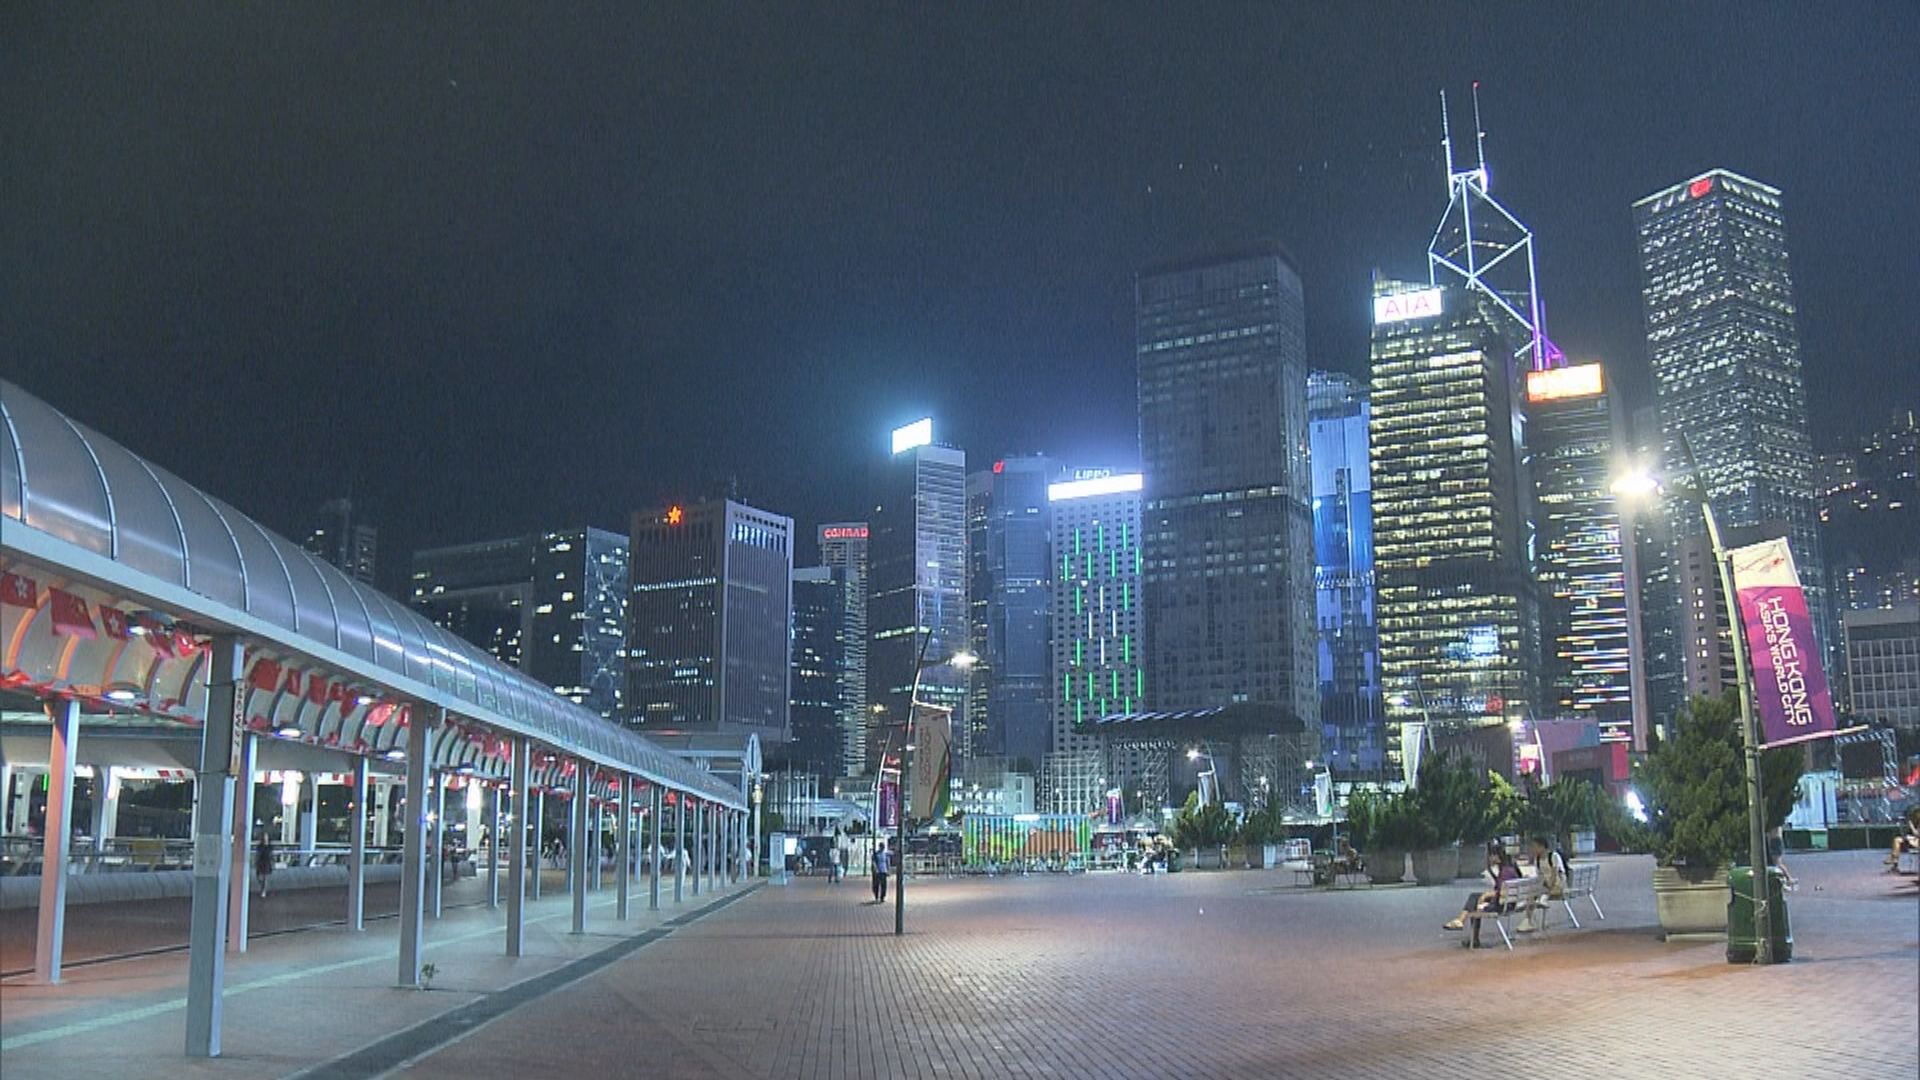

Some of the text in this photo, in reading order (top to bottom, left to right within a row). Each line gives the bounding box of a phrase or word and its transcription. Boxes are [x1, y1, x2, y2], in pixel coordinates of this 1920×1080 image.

[1384, 295, 1431, 317] AIA
[824, 527, 868, 538] CONRAD
[1758, 602, 1797, 726] ASIA'S WORLD CITY
[1767, 596, 1812, 726] HONG KONG
